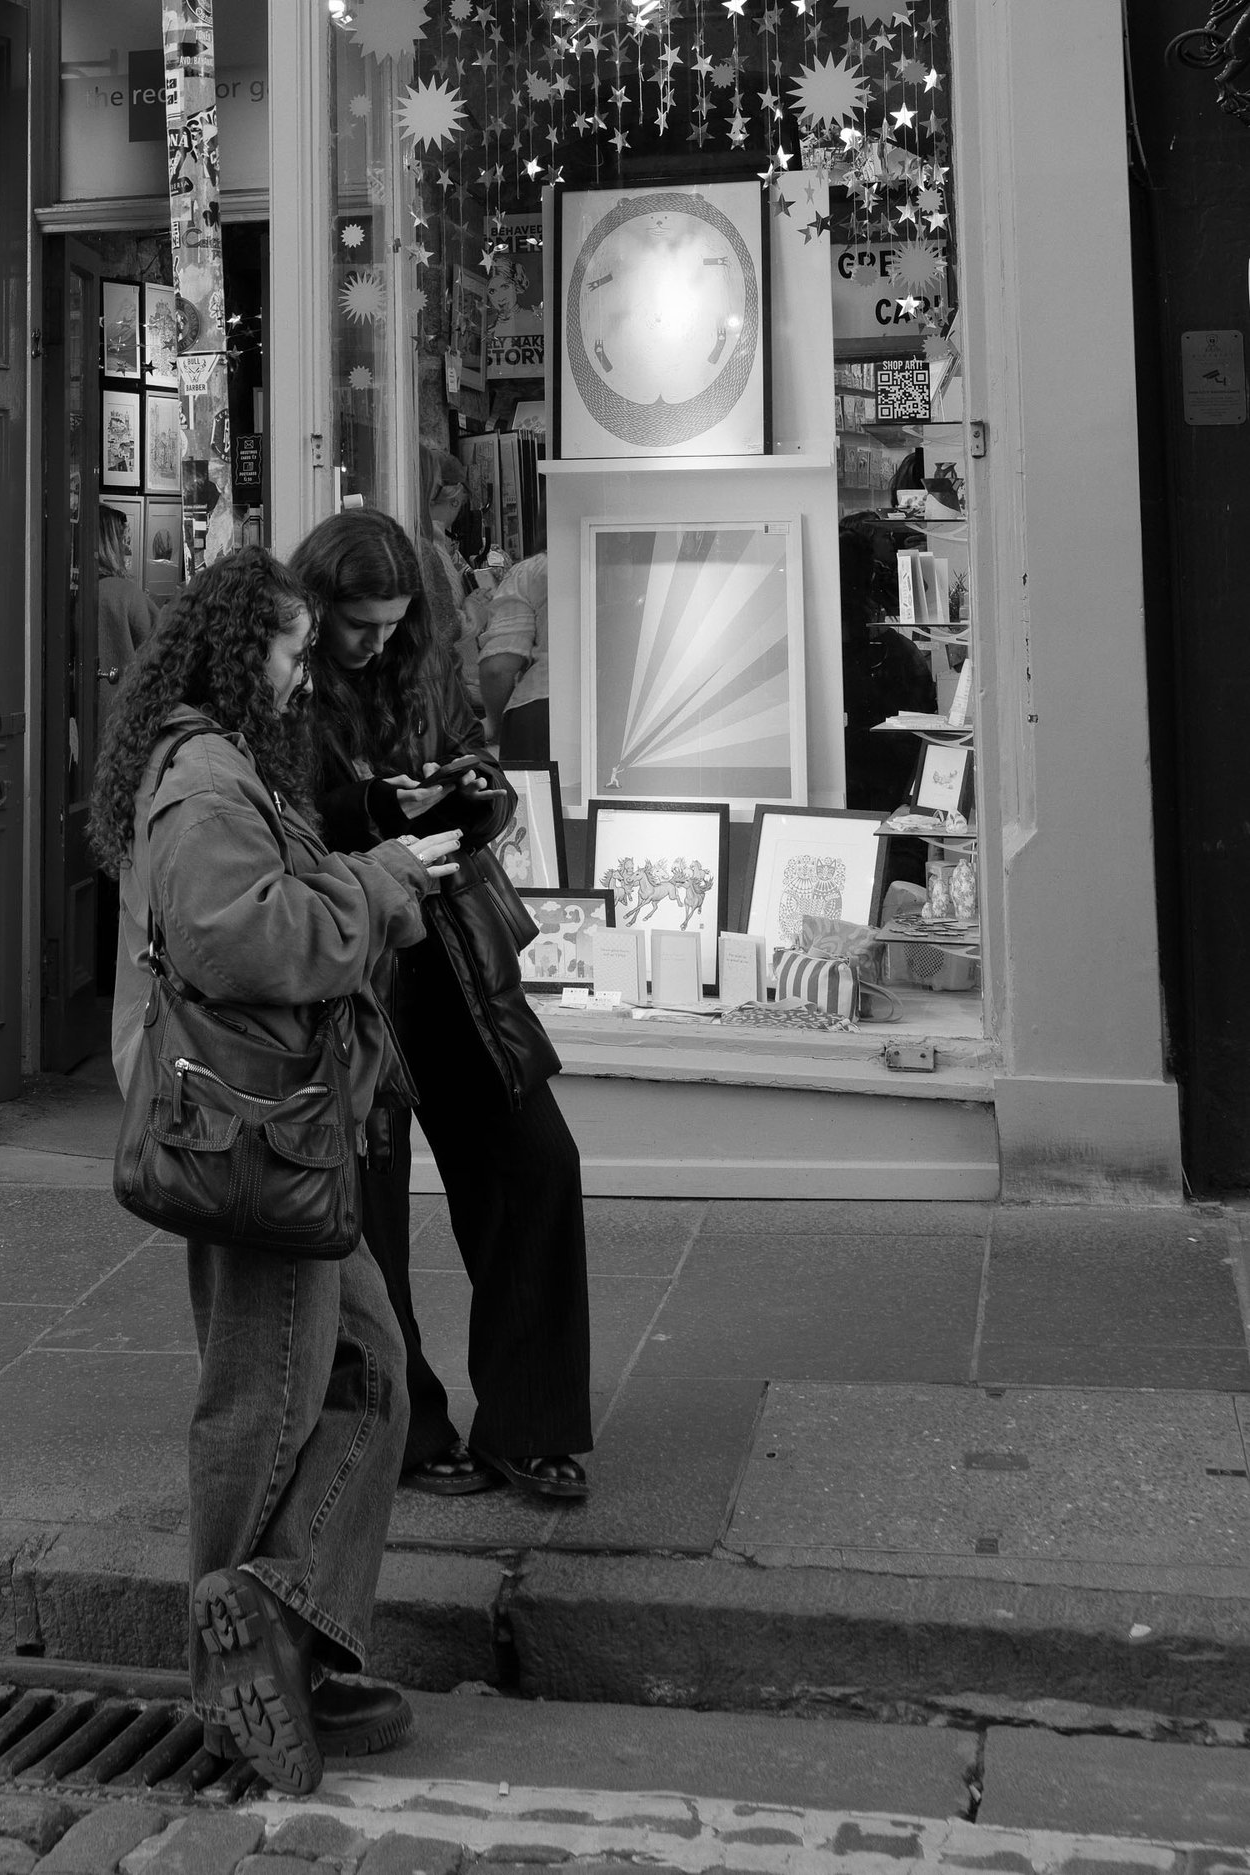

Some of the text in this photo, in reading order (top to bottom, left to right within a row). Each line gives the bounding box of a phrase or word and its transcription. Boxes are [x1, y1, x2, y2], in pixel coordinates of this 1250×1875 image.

[86, 86, 124, 106] the
[491, 225, 543, 236] BEHAVED
[883, 360, 923, 370] SHOP ART!
